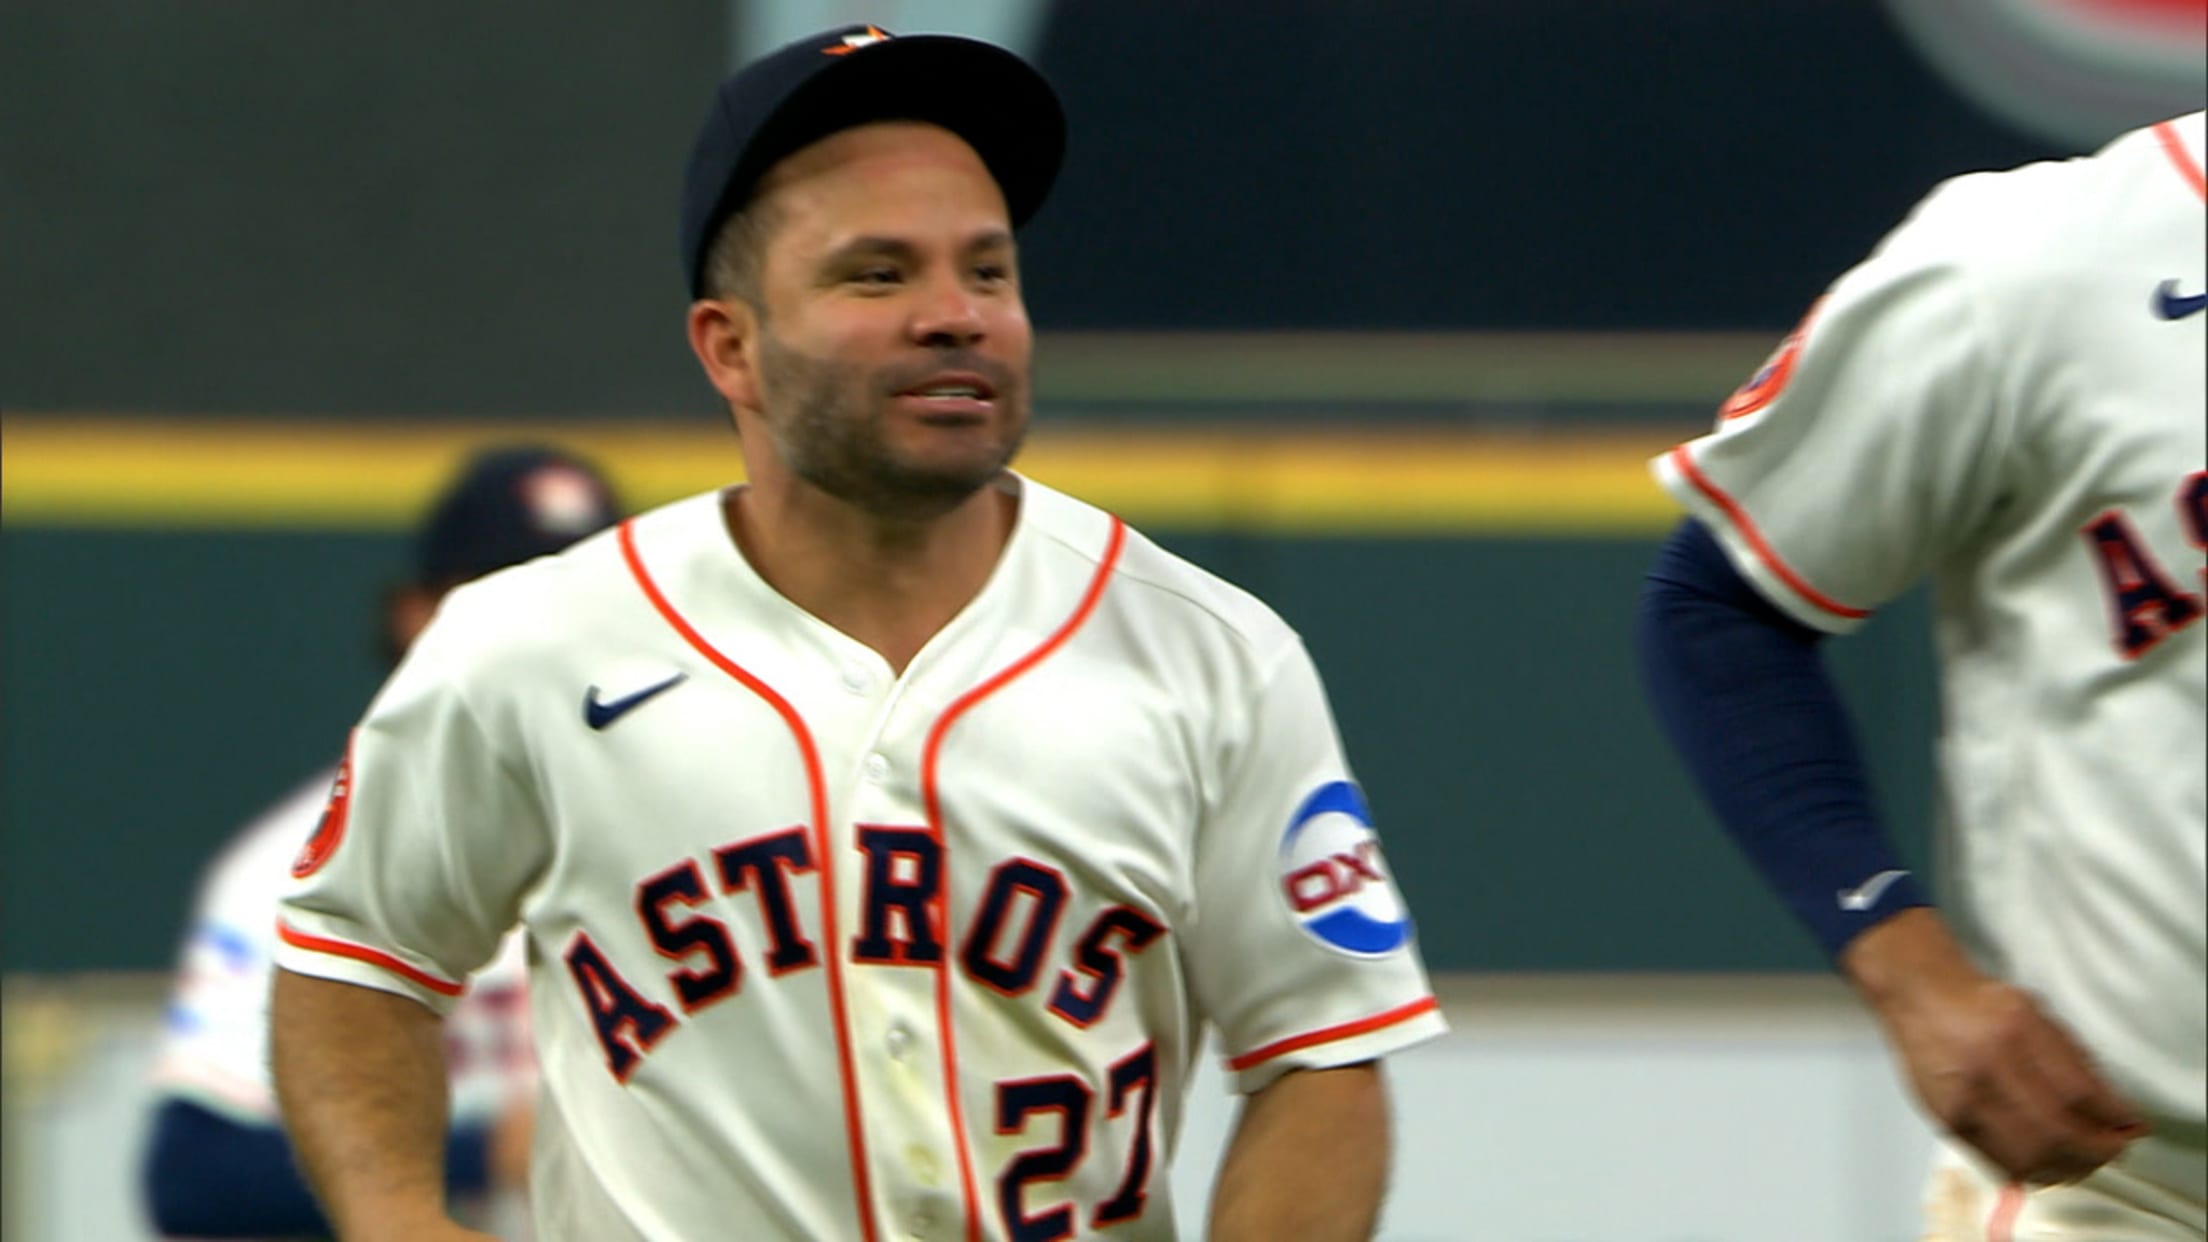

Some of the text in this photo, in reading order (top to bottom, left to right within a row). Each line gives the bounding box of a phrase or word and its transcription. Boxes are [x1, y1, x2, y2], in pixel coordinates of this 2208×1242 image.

[563, 824, 1169, 1085] ASTROS
[1281, 839, 1384, 914] OX
[993, 1038, 1158, 1242] 27
